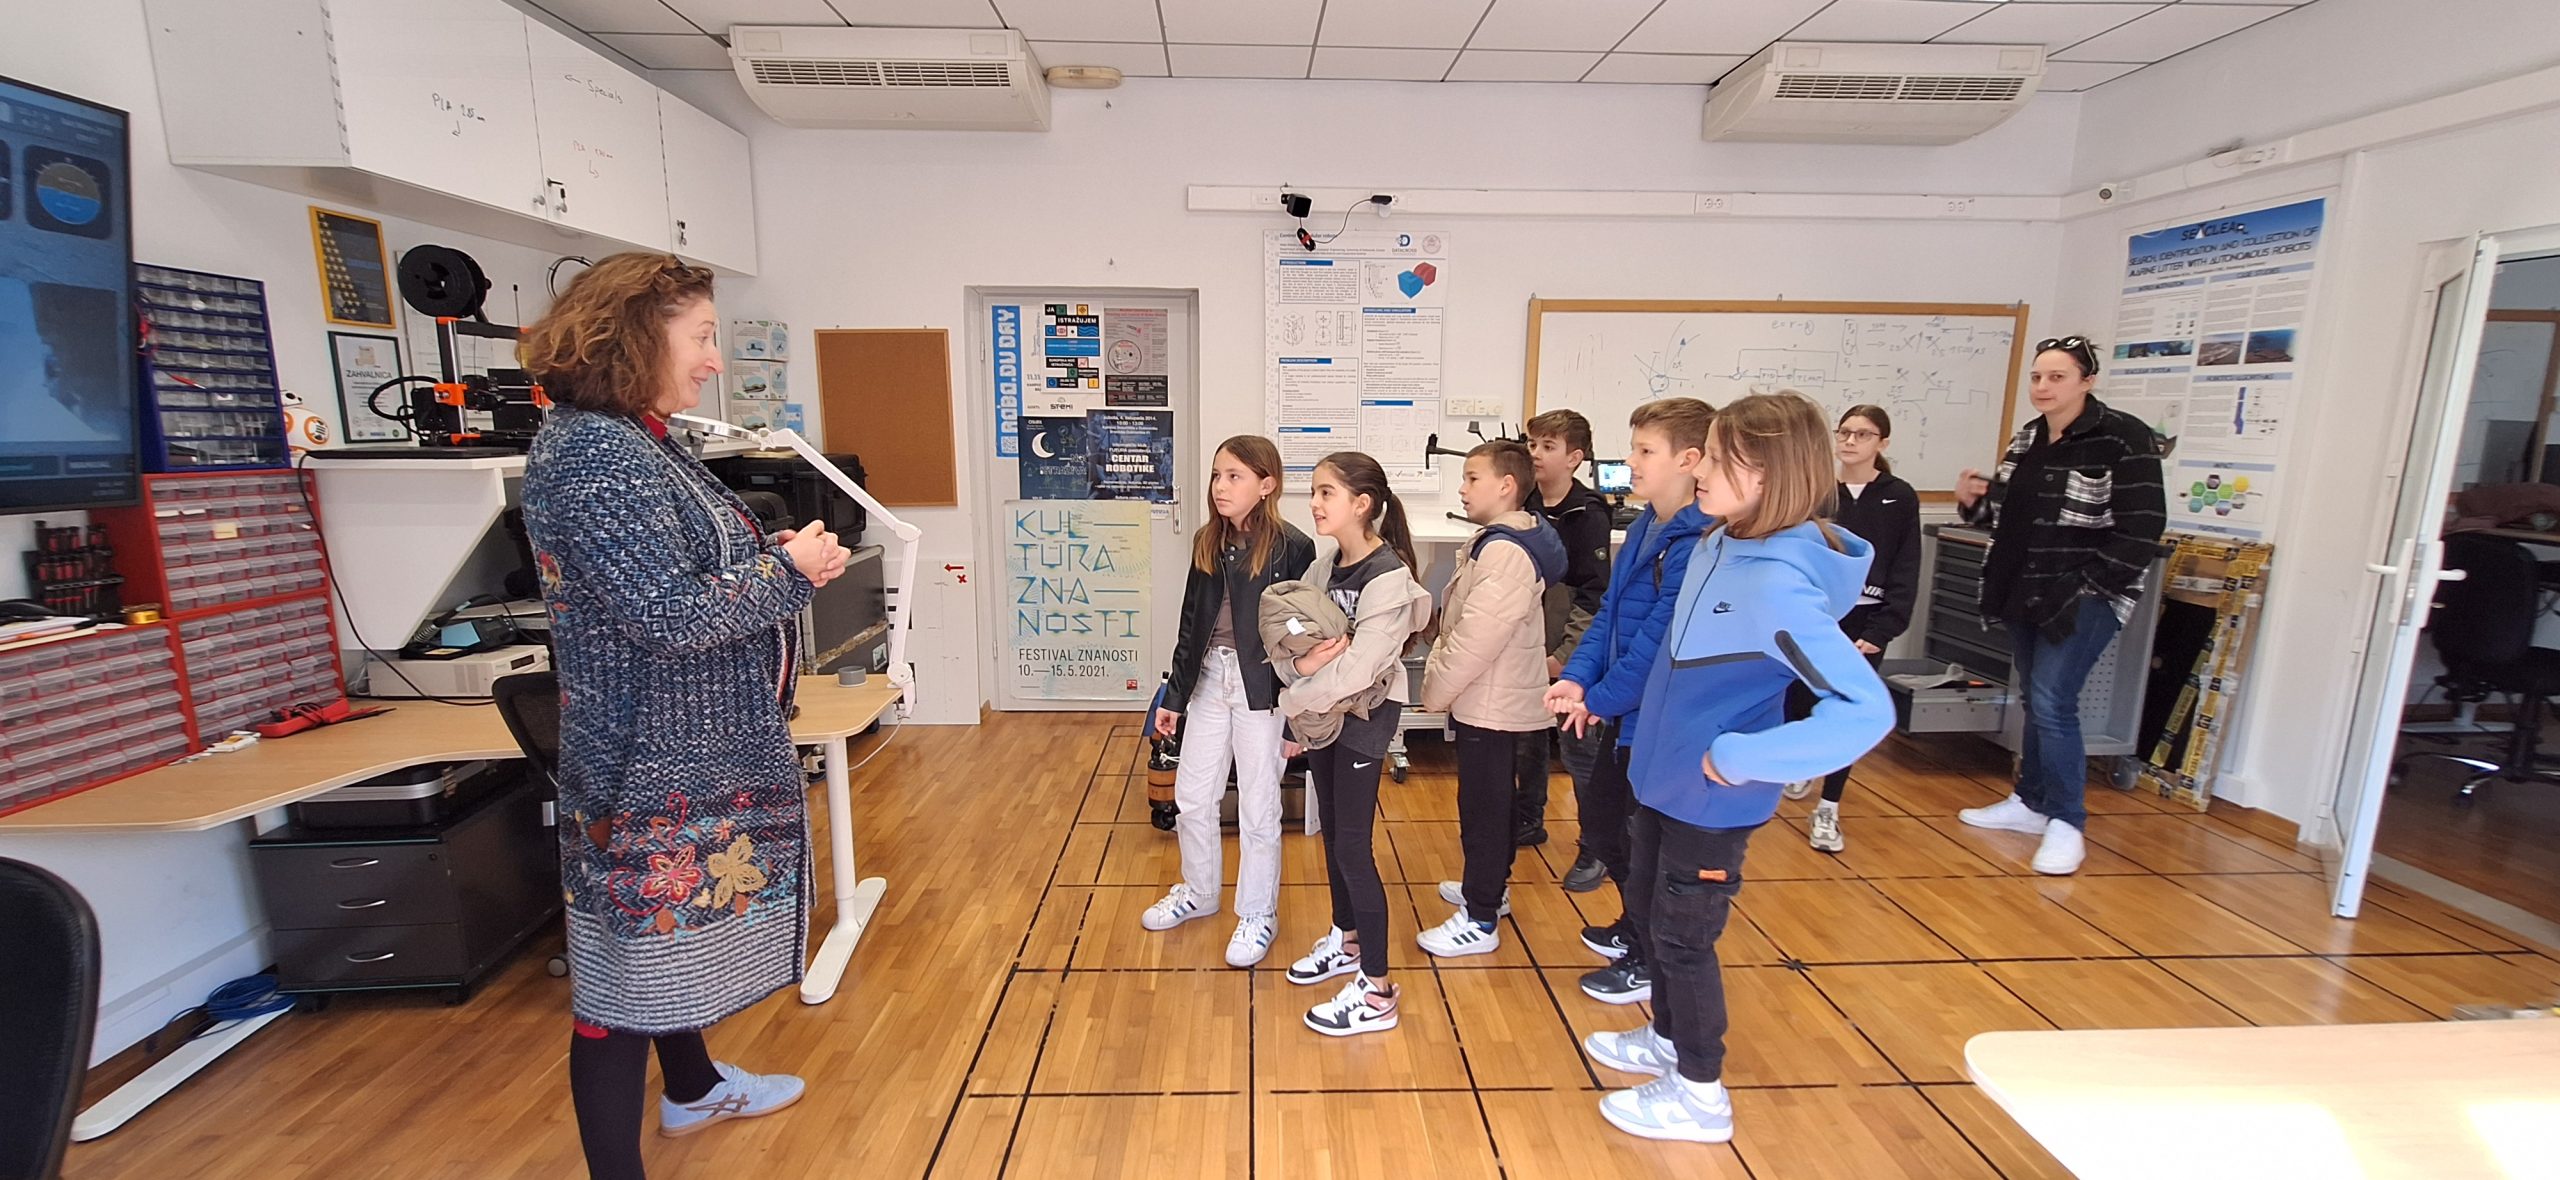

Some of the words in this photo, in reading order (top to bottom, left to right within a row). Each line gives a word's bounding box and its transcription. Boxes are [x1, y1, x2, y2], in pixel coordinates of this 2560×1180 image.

[2158, 261, 2184, 273] LITTER
[2188, 256, 2208, 268] WITH
[2272, 240, 2312, 256] ROBOTS
[2159, 244, 2219, 262] IDENTIFICATION
[2222, 240, 2240, 252] AND
[2242, 230, 2302, 248] COLLECTION
[2304, 225, 2319, 238] OF
[997, 308, 1016, 347] DAY
[1058, 316, 1097, 324] ISTRAŽUJEM
[346, 370, 392, 379] ZAHVALNICA
[1016, 510, 1089, 538] KUL
[1014, 544, 1115, 572] TURA
[1016, 576, 1090, 604] ZNA
[1018, 609, 1140, 638] NOSTI
[1019, 648, 1074, 662] FESTIVAL
[1078, 649, 1138, 662] ZNANOSTI
